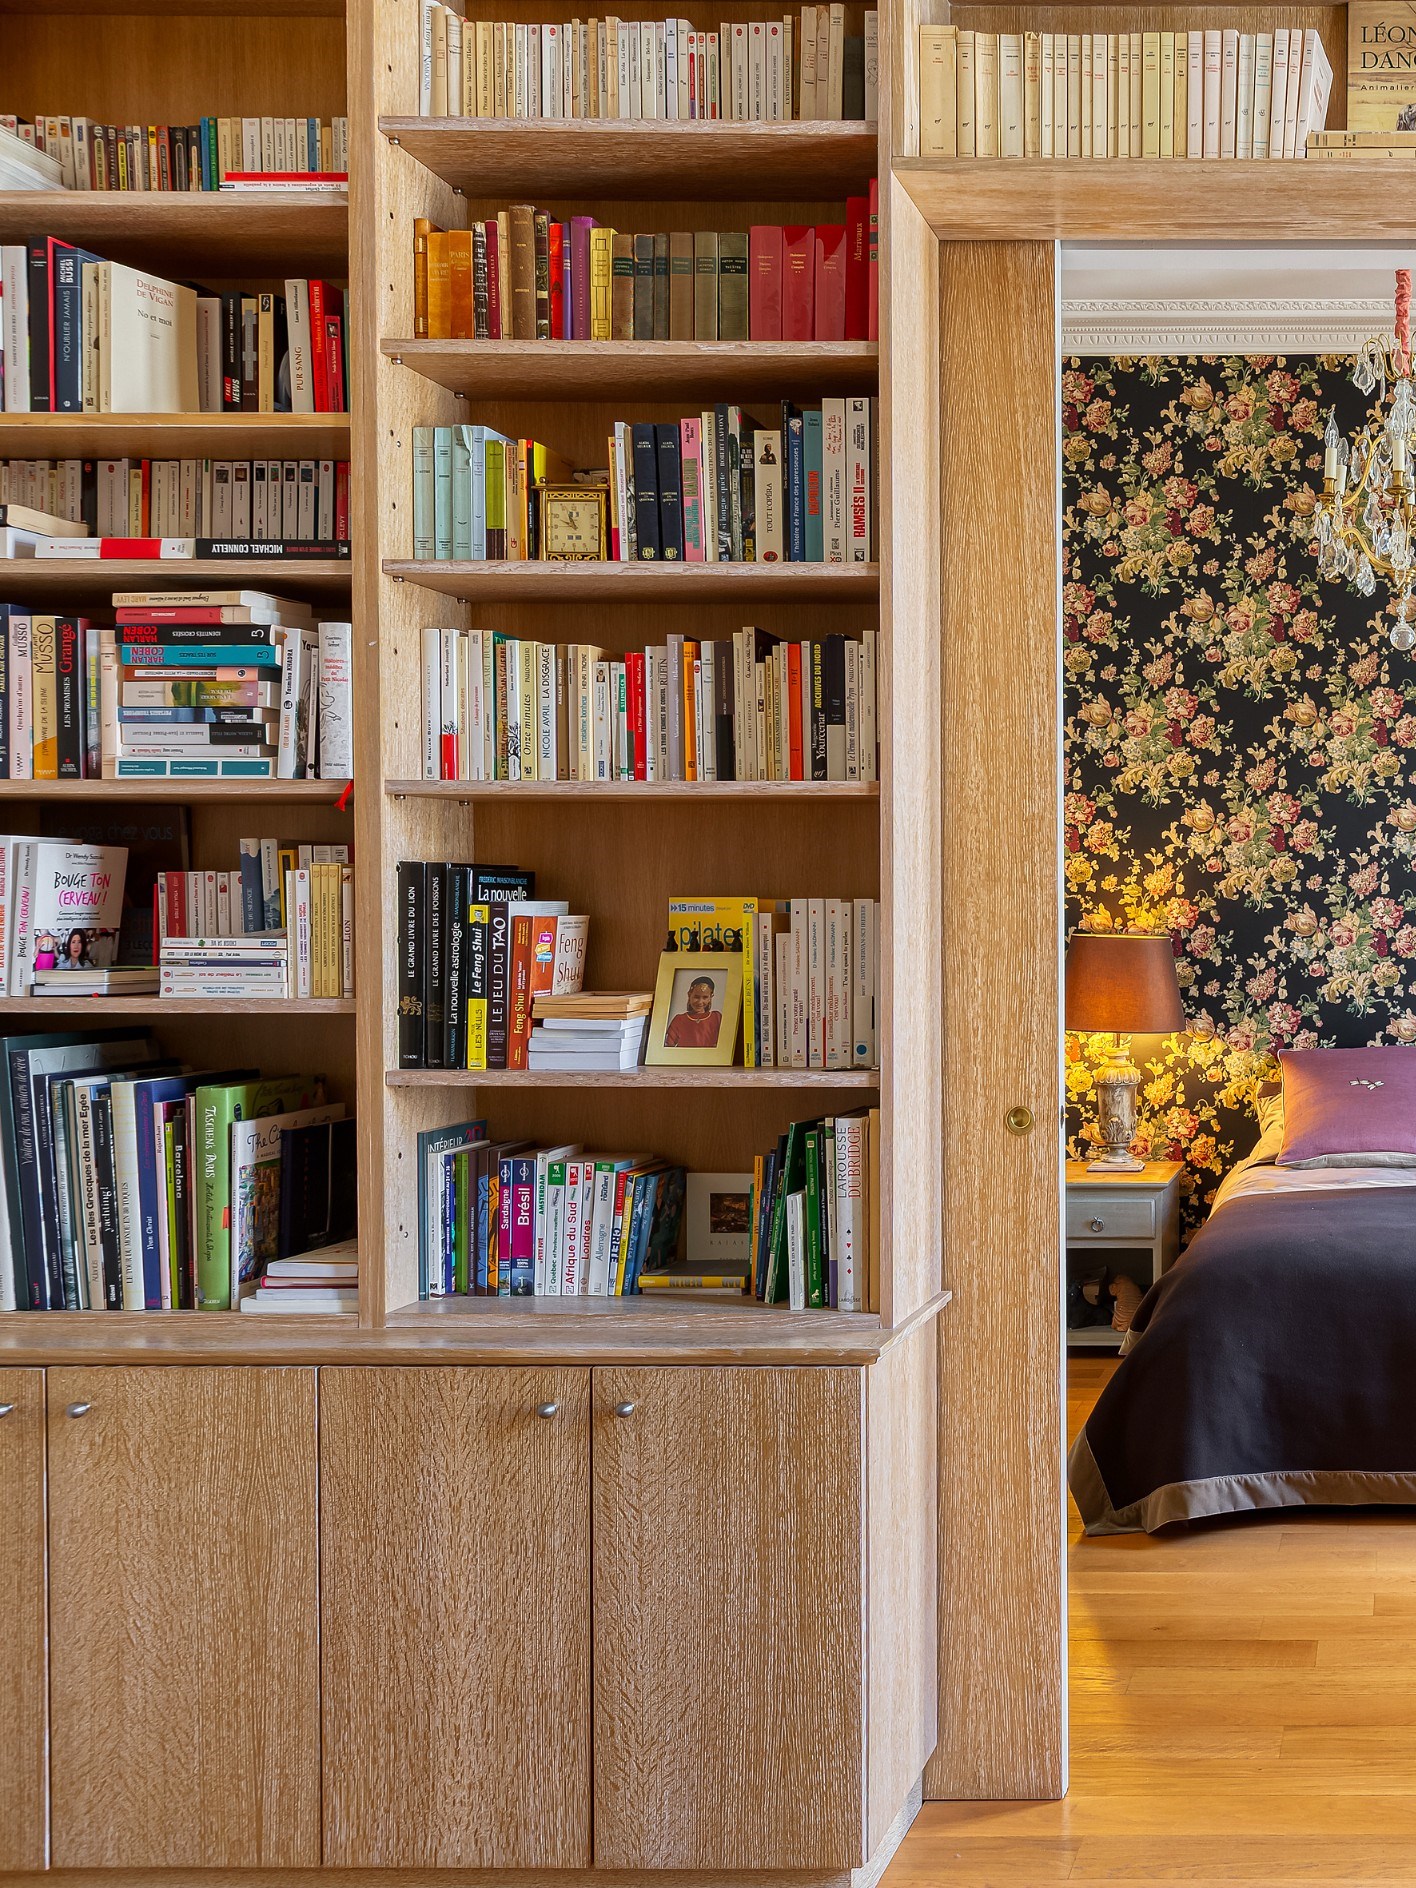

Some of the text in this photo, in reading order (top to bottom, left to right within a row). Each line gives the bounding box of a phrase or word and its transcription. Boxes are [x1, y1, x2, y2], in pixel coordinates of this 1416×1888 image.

[423, 27, 431, 48] Troyat
[1361, 83, 1415, 91] Animalier
[853, 222, 863, 261] Marivaux
[65, 259, 73, 283] BUSSI
[136, 279, 174, 300] DELPHINE
[63, 290, 71, 319] JAMAIS
[136, 289, 174, 308] DE VIGAN
[684, 458, 697, 497] BABUR
[851, 495, 866, 537] RAMSÈS
[212, 543, 249, 553] CONNELLY
[250, 543, 282, 553] MICHAEL
[19, 623, 28, 657] MUSSO
[36, 624, 54, 673] MUSSO
[59, 624, 76, 673] Grangé
[131, 647, 164, 655] COBEN
[542, 648, 550, 686] DISGRACE
[815, 665, 821, 675] DU
[543, 688, 549, 699] LA
[523, 694, 531, 755] Onze minutes
[816, 712, 826, 759] Yourcenar
[54, 872, 111, 889] BOUGE TON
[478, 885, 527, 901] La nouvelle
[408, 907, 415, 917] DU
[678, 904, 714, 912] 15 minutes
[472, 928, 484, 993] Le Feng Shui
[558, 934, 584, 959] Feng
[449, 922, 462, 1024] La nouvelle astrologie
[493, 917, 505, 1022] LE JEU DU TAO
[514, 993, 526, 1033] Feng Shui
[78, 1094, 97, 1246] Les Iles Grecques de la mer Egée
[174, 1145, 184, 1198] Barcelona
[838, 1128, 847, 1198] LAROUSSE
[847, 1127, 861, 1198] DU BRIDGE
[100, 1186, 114, 1233] yachting!
[502, 1189, 510, 1229] Sardaigne
[518, 1188, 531, 1226] Brésil
[566, 1202, 577, 1284] Afrique du Sud
[582, 1220, 590, 1260] Londres
[595, 1224, 606, 1261] Allemagne
